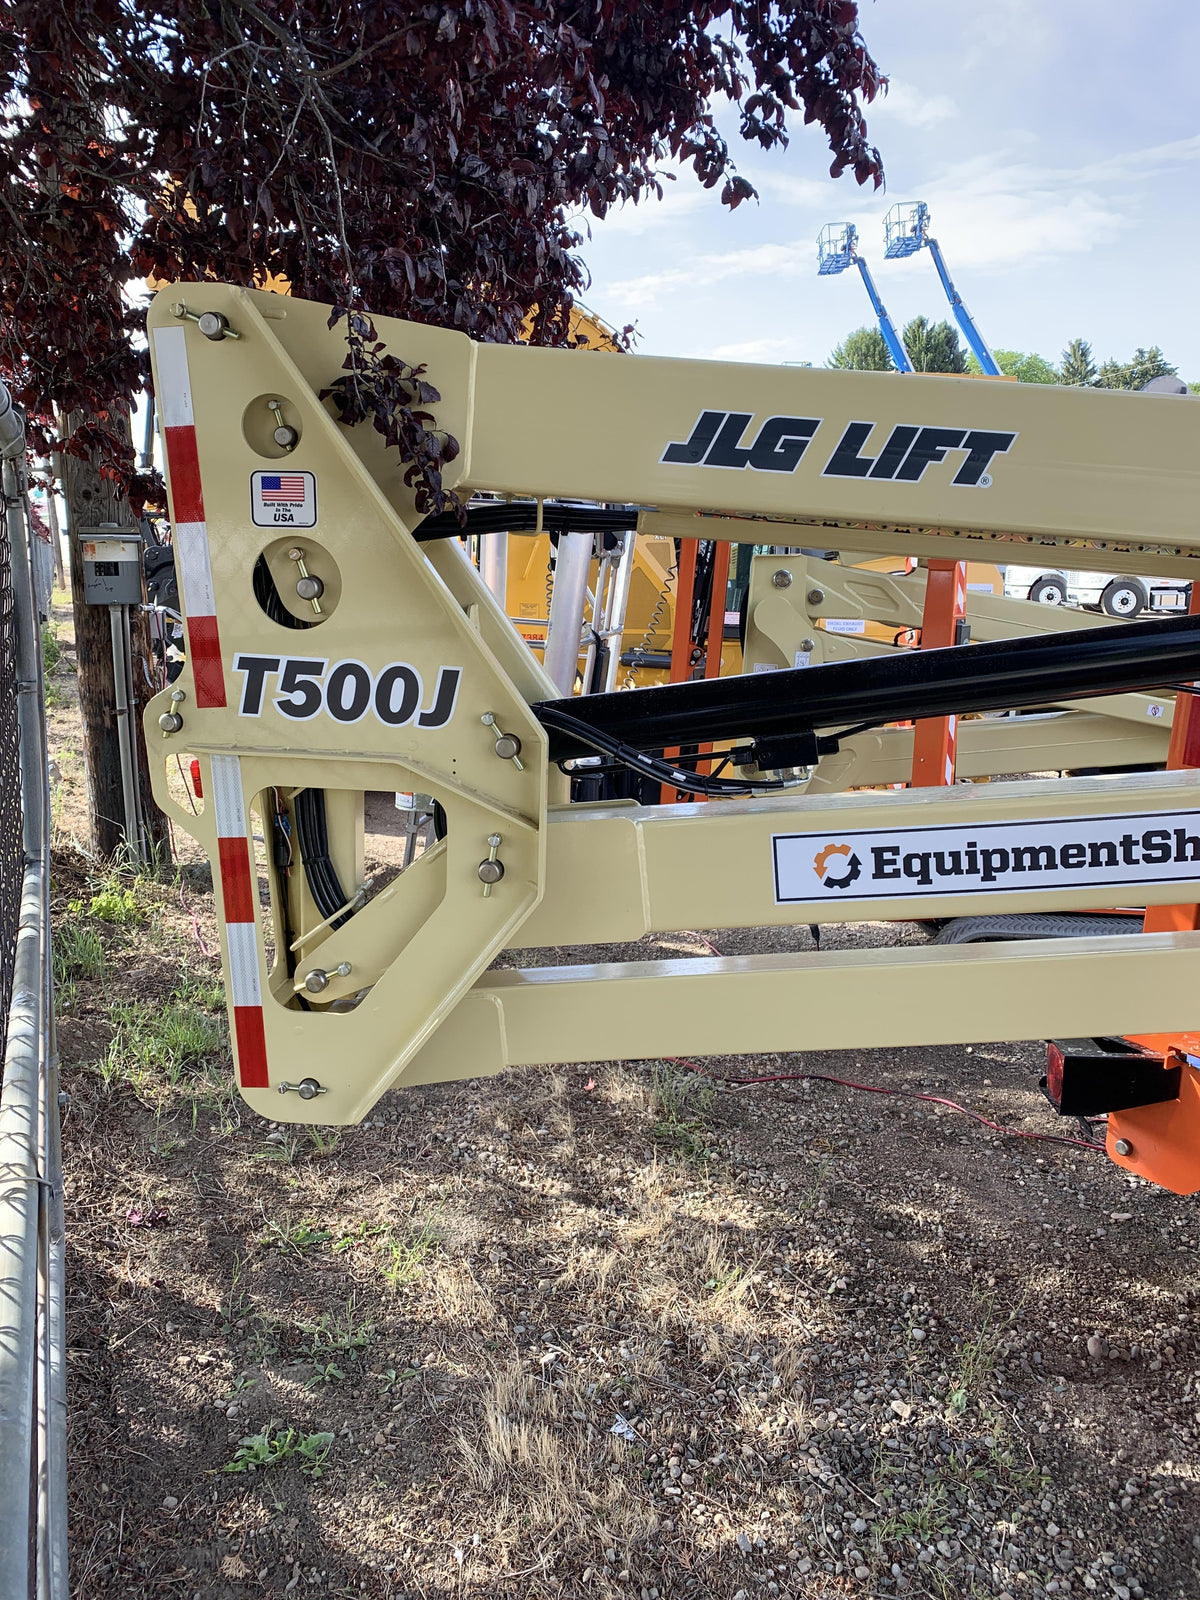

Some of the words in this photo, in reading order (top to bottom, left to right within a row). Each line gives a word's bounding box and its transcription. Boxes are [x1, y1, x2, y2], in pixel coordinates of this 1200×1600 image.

[658, 409, 824, 474] JLG
[273, 513, 294, 522] USA
[232, 653, 463, 730] T500J
[871, 828, 1200, 885] EquipmentSh
